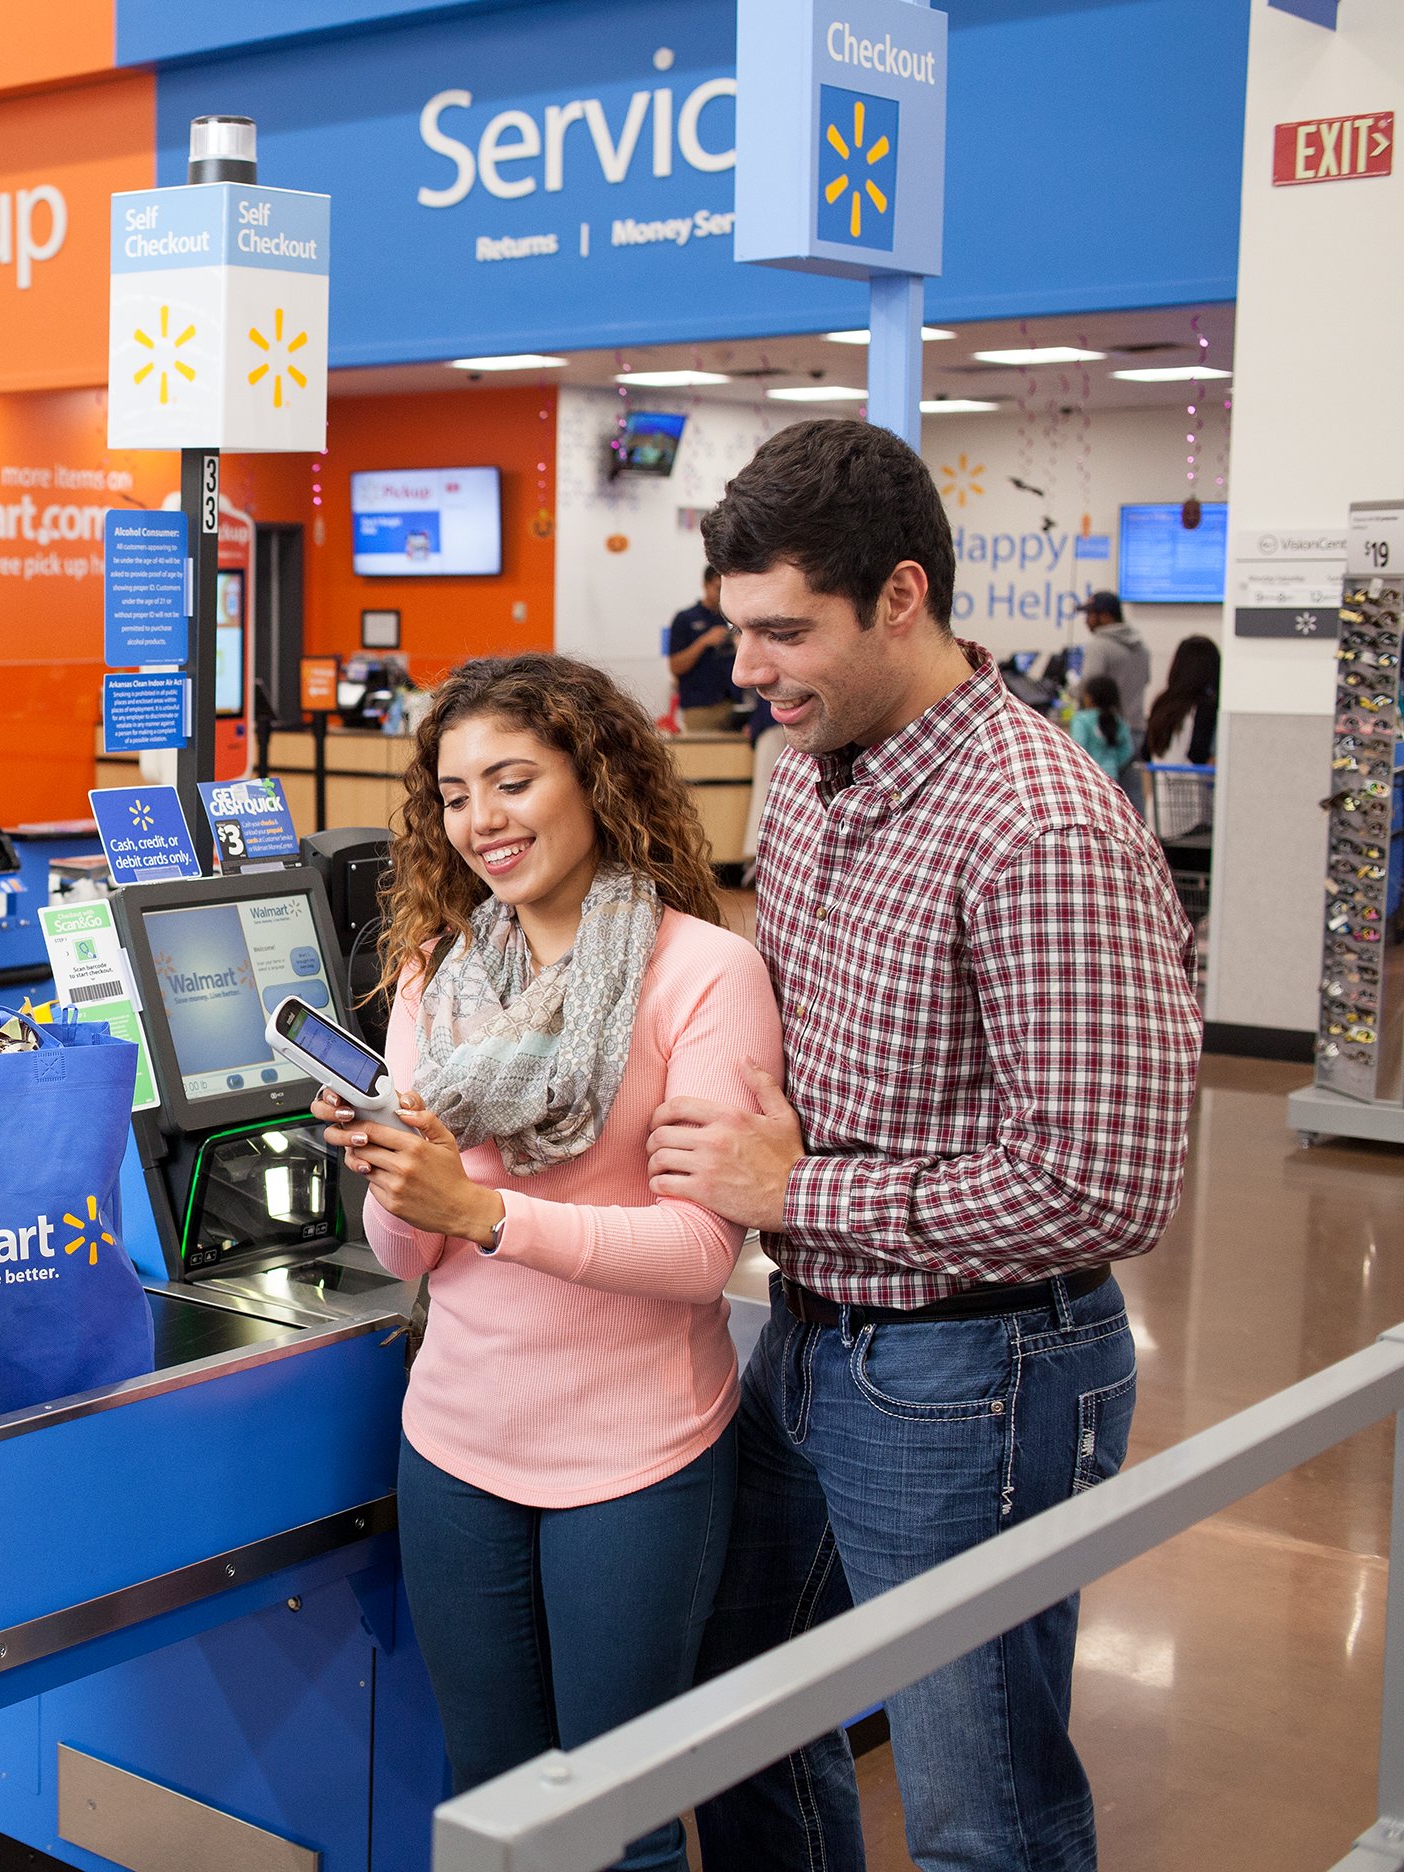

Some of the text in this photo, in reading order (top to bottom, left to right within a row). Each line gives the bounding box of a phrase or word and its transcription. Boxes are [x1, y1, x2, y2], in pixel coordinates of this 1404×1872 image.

[826, 21, 936, 85] Checkout
[417, 47, 737, 208] Servic
[1295, 118, 1375, 180] EXIT
[124, 205, 159, 233] Self
[238, 200, 271, 227] Self
[124, 230, 210, 259] Checkout
[237, 228, 317, 260] Checkout
[475, 233, 559, 262] Returns
[611, 216, 693, 247] Money
[1, 466, 52, 488] more
[54, 464, 105, 490] items
[106, 470, 133, 491] on
[114, 527, 180, 537] Alcohol Consumer:
[23, 551, 61, 582] pick
[63, 559, 89, 582] up
[1365, 540, 1390, 568] $19
[113, 584, 133, 592] showing
[176, 571, 183, 579] by
[108, 681, 132, 689] Arkansas
[132, 680, 147, 688] Clean
[148, 679, 164, 687] Indoor
[209, 796, 285, 816] CASH QUICK
[109, 834, 179, 853] Cash, credit, or
[115, 852, 192, 869] debit cards only.
[53, 915, 103, 933] Scan&Go
[250, 904, 289, 919] Walmart
[72, 962, 107, 973] Scan barcode
[168, 967, 238, 995] Walmart
[5, 1266, 60, 1284] better.
